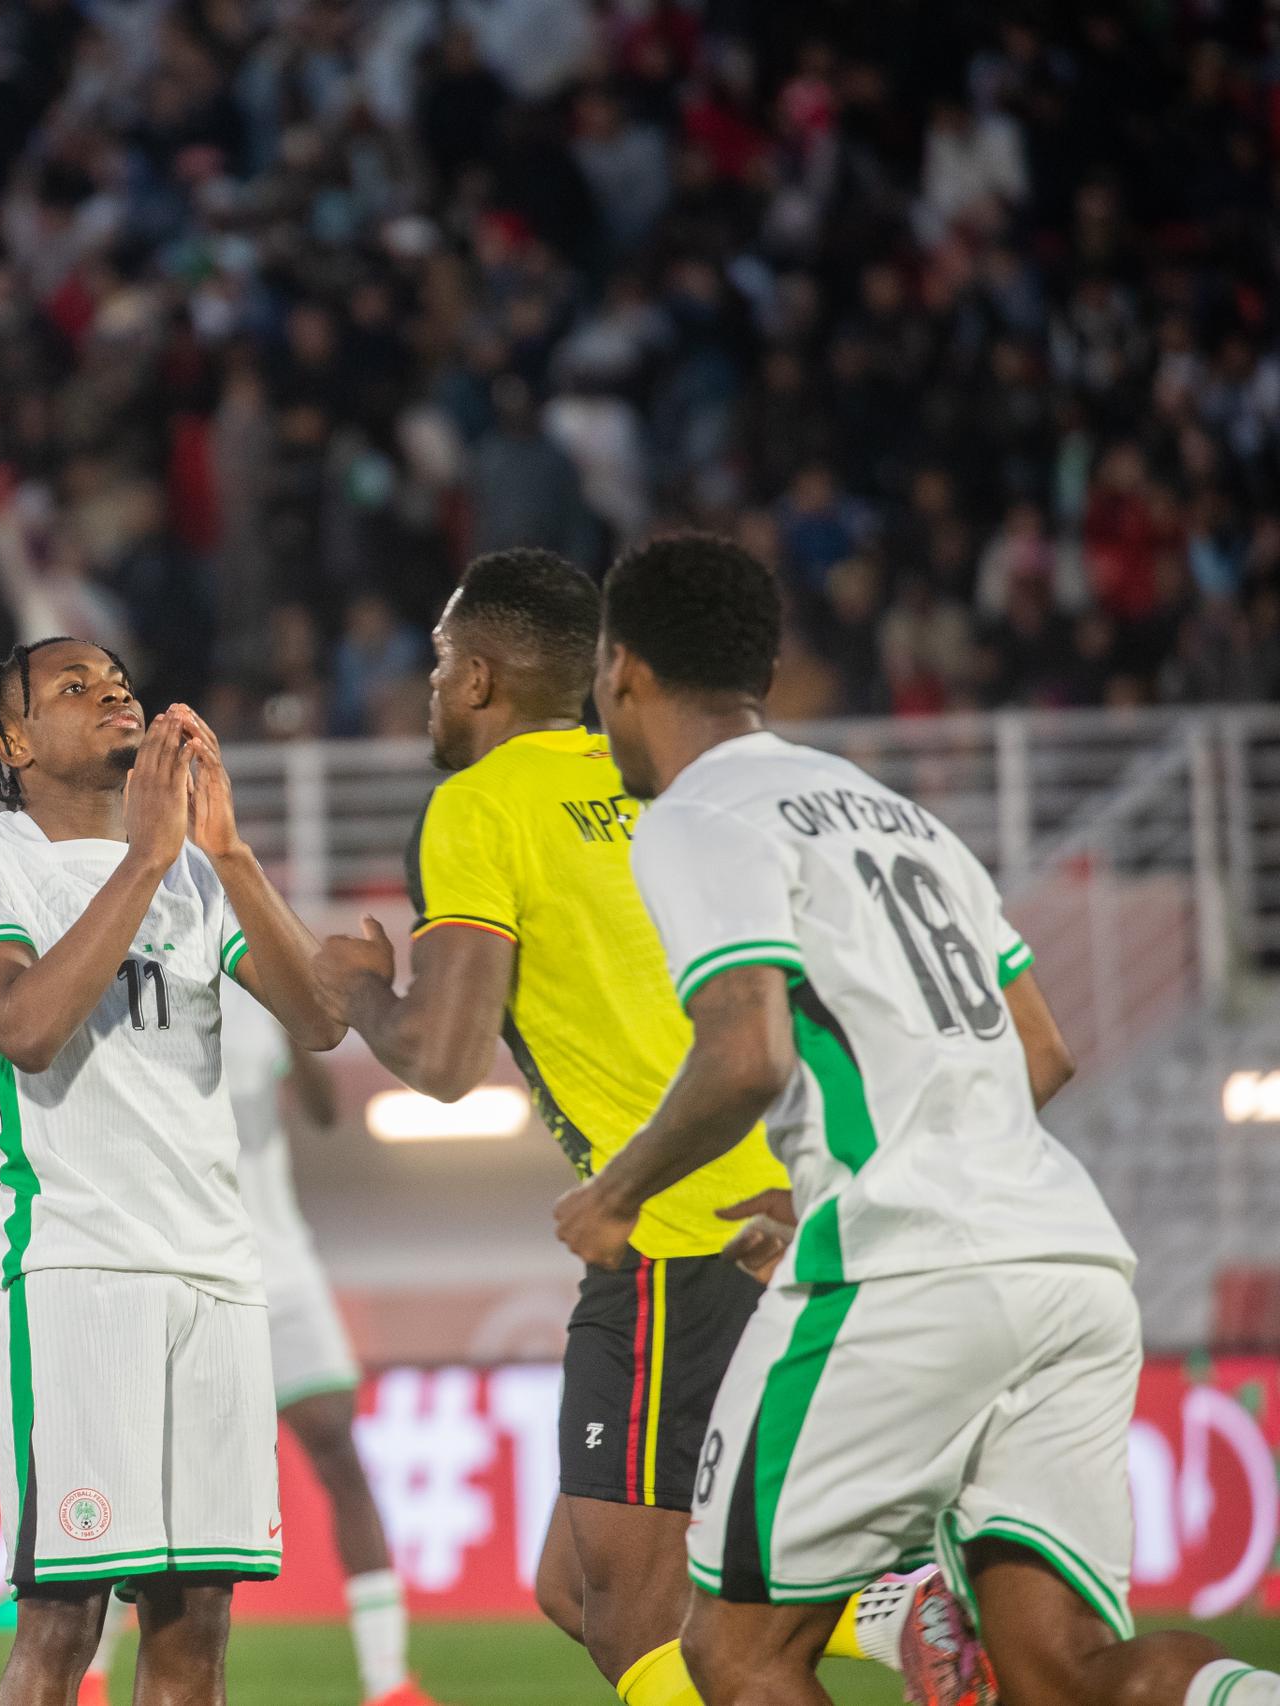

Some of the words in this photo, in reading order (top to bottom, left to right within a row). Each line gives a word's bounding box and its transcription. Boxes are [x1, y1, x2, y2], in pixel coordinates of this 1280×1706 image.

[854, 847, 1008, 1041] 18
[117, 959, 171, 1030] 11
[64, 1491, 92, 1507] FOOTBALL
